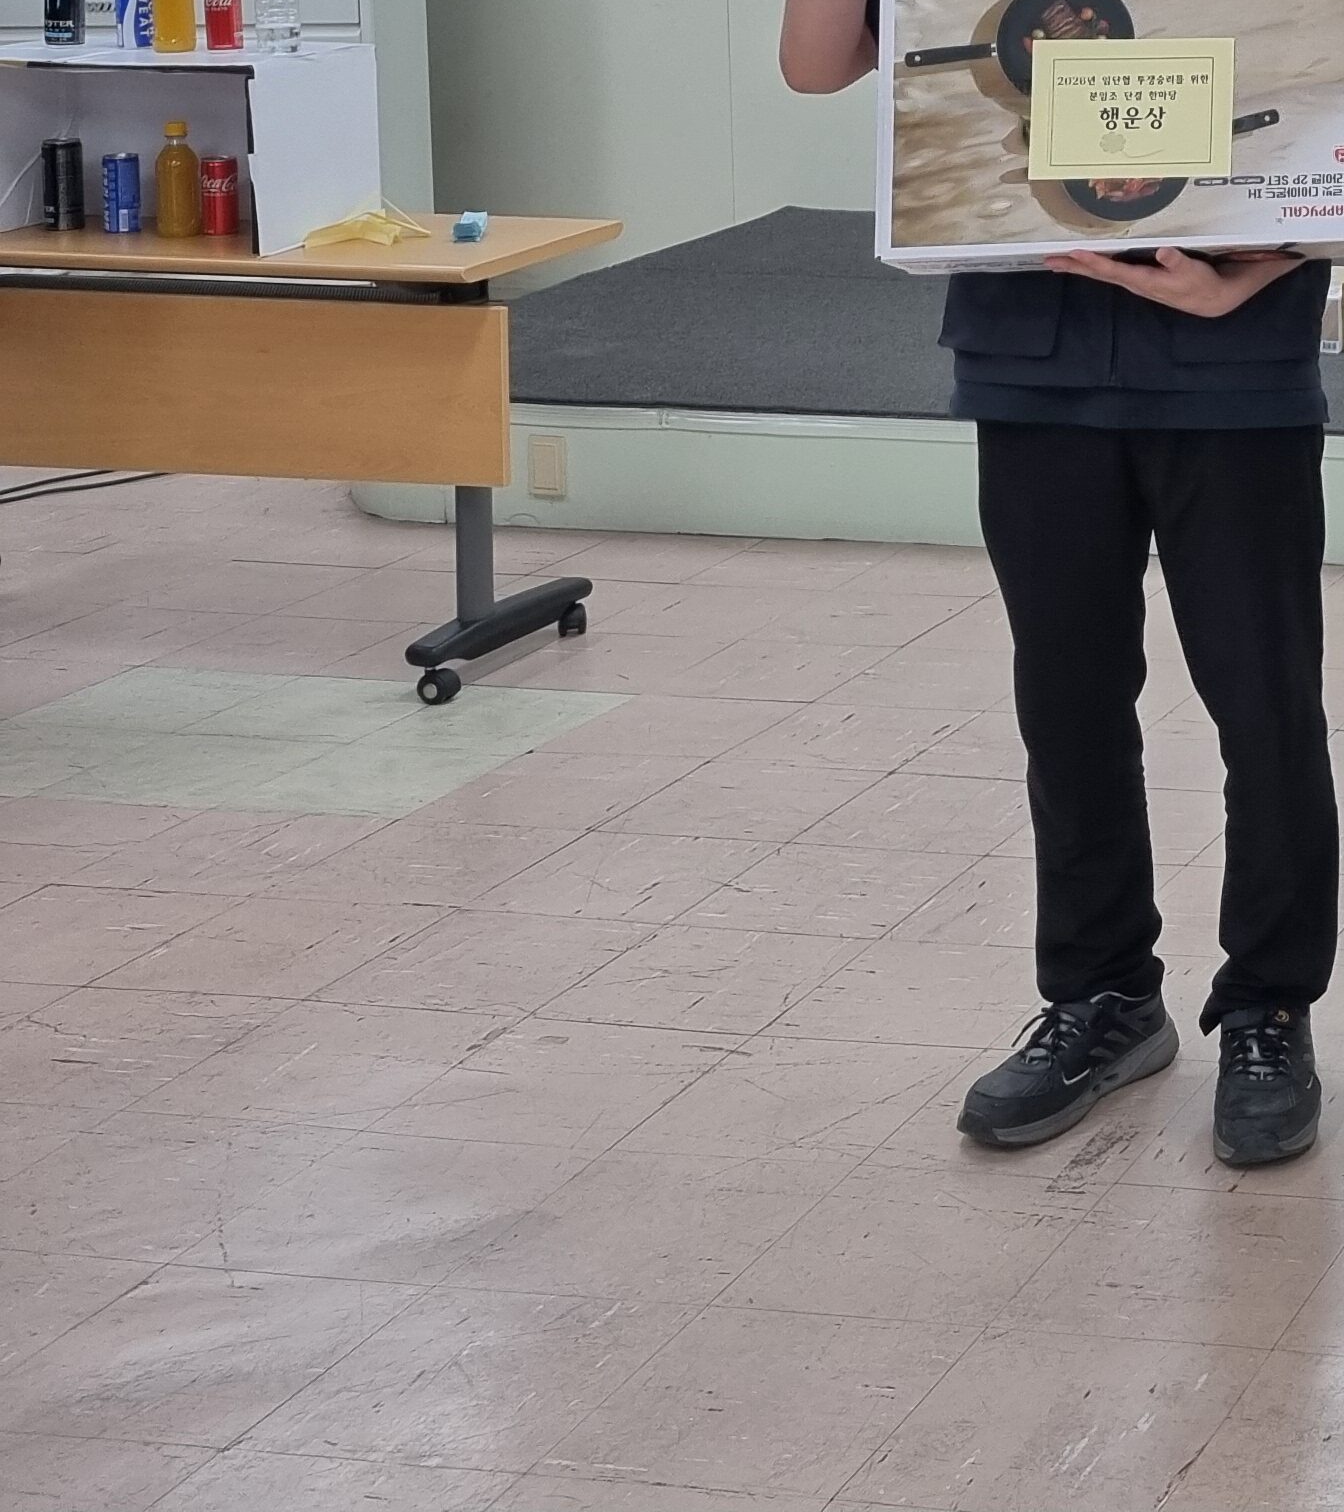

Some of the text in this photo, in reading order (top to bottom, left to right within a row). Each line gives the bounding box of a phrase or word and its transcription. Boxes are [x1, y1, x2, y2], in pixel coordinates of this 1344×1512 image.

[1057, 75, 1096, 86] 2026년
[1102, 75, 1130, 86] 임단협
[1190, 74, 1209, 85] 위한
[1089, 91, 1118, 101] 분임조
[1124, 91, 1143, 101] 단결
[1099, 106, 1166, 131] 행운상
[1265, 175, 1288, 185] SET
[1292, 174, 1307, 184] 2P
[1247, 188, 1262, 198] IH
[1265, 185, 1318, 198] 다이아몬드
